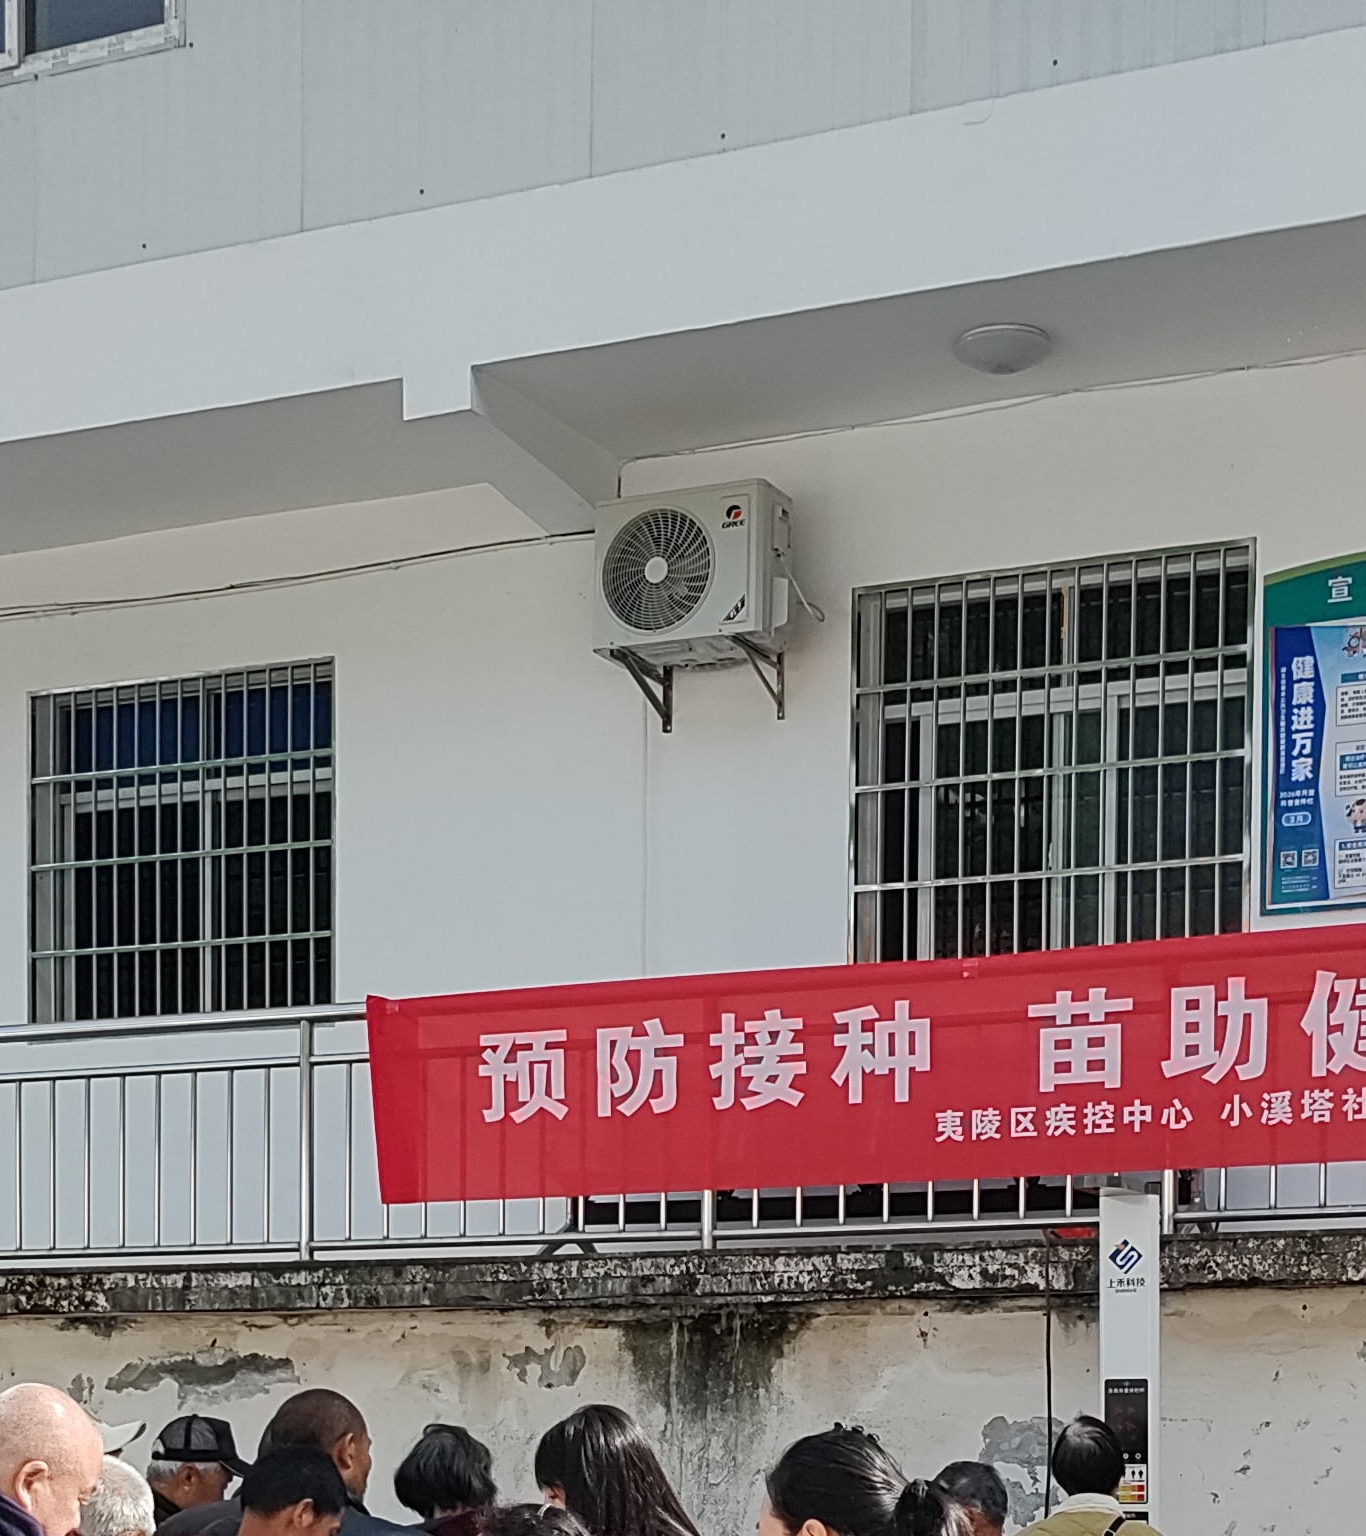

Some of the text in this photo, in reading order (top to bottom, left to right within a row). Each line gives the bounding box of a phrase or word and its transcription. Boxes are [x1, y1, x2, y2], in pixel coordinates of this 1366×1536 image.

[1291, 655, 1316, 783] 健康进万家
[478, 1000, 933, 1124] 预防接种
[934, 1099, 1194, 1143] 夷陵区疾控中心
